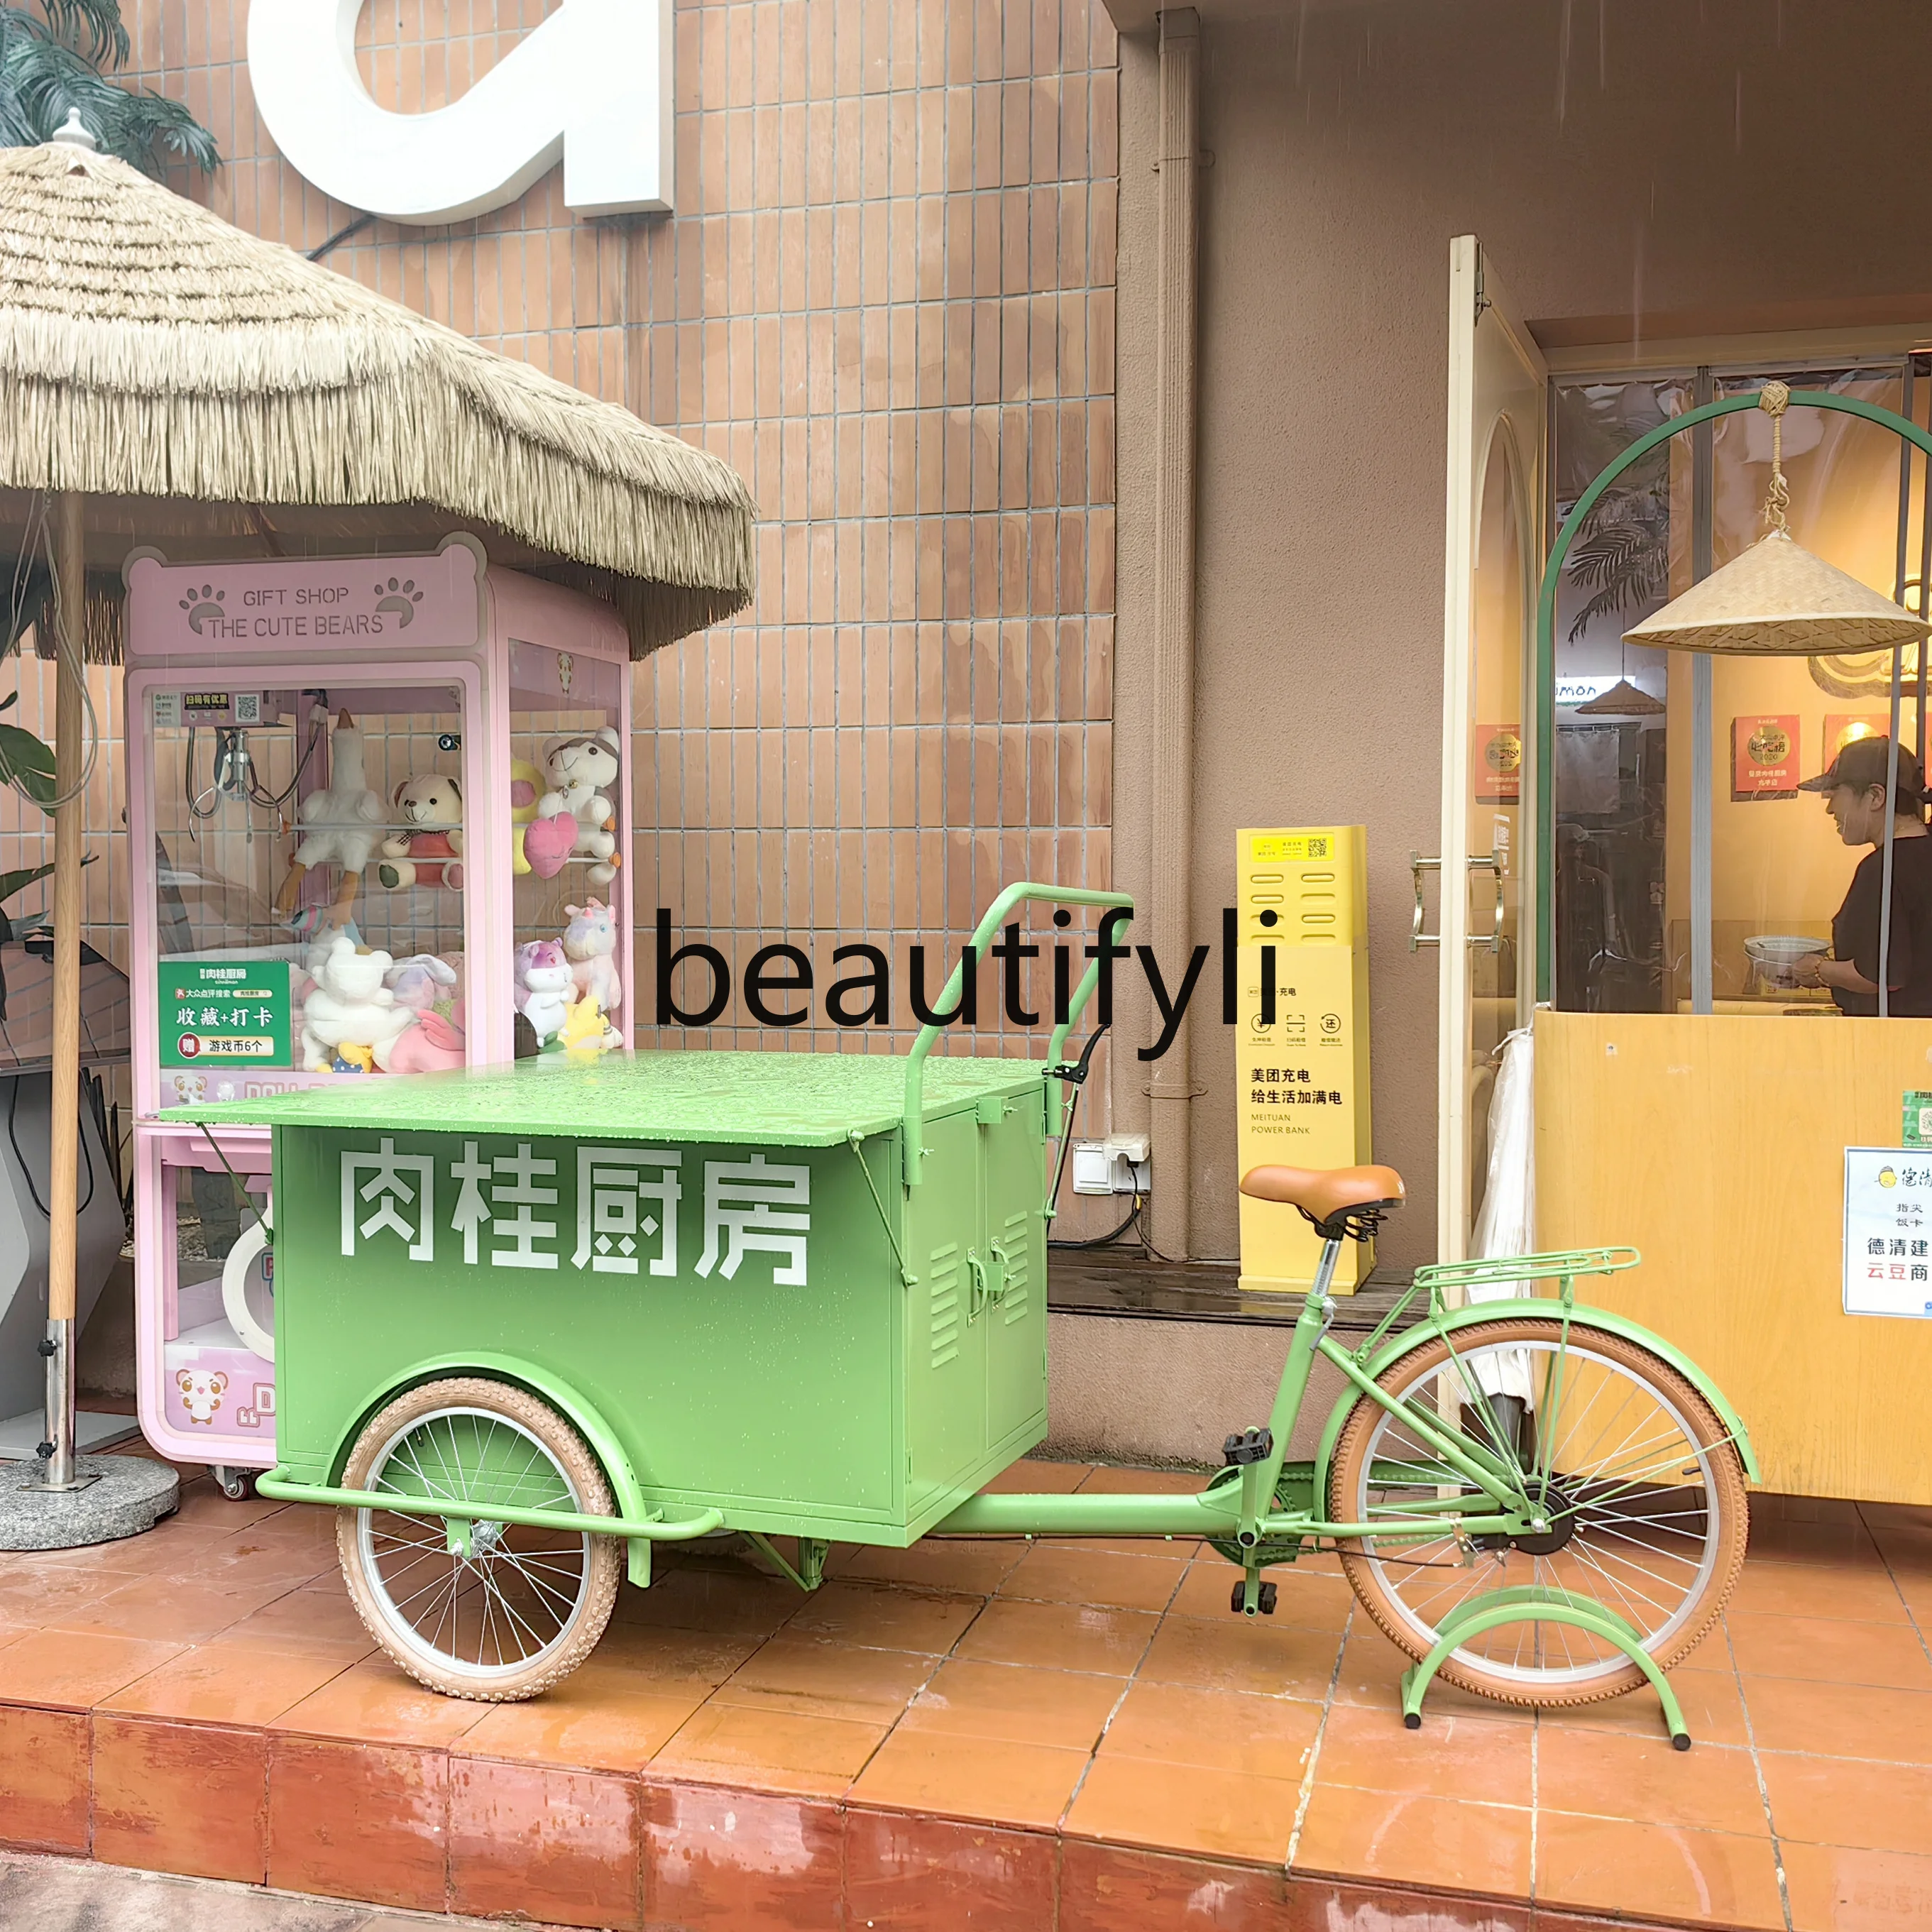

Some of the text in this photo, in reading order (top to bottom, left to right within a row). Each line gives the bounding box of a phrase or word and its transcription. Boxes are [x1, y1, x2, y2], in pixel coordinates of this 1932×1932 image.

[243, 587, 349, 606] GIFT SHOP
[209, 615, 383, 638] THE CUTE BEARS
[186, 989, 231, 999] 大众点评搜索
[209, 1040, 263, 1053] 游戏币6个
[1251, 1068, 1311, 1083] 美团充电
[1251, 1090, 1343, 1105] 给生活加满电
[1251, 1126, 1283, 1134] POWER
[340, 1137, 811, 1286] 肉桂厨房
[1896, 1203, 1923, 1213] 指尖
[1895, 1218, 1923, 1228] 饭卡
[1867, 1237, 1929, 1257] 德清建
[1867, 1261, 1928, 1282] 云豆商
